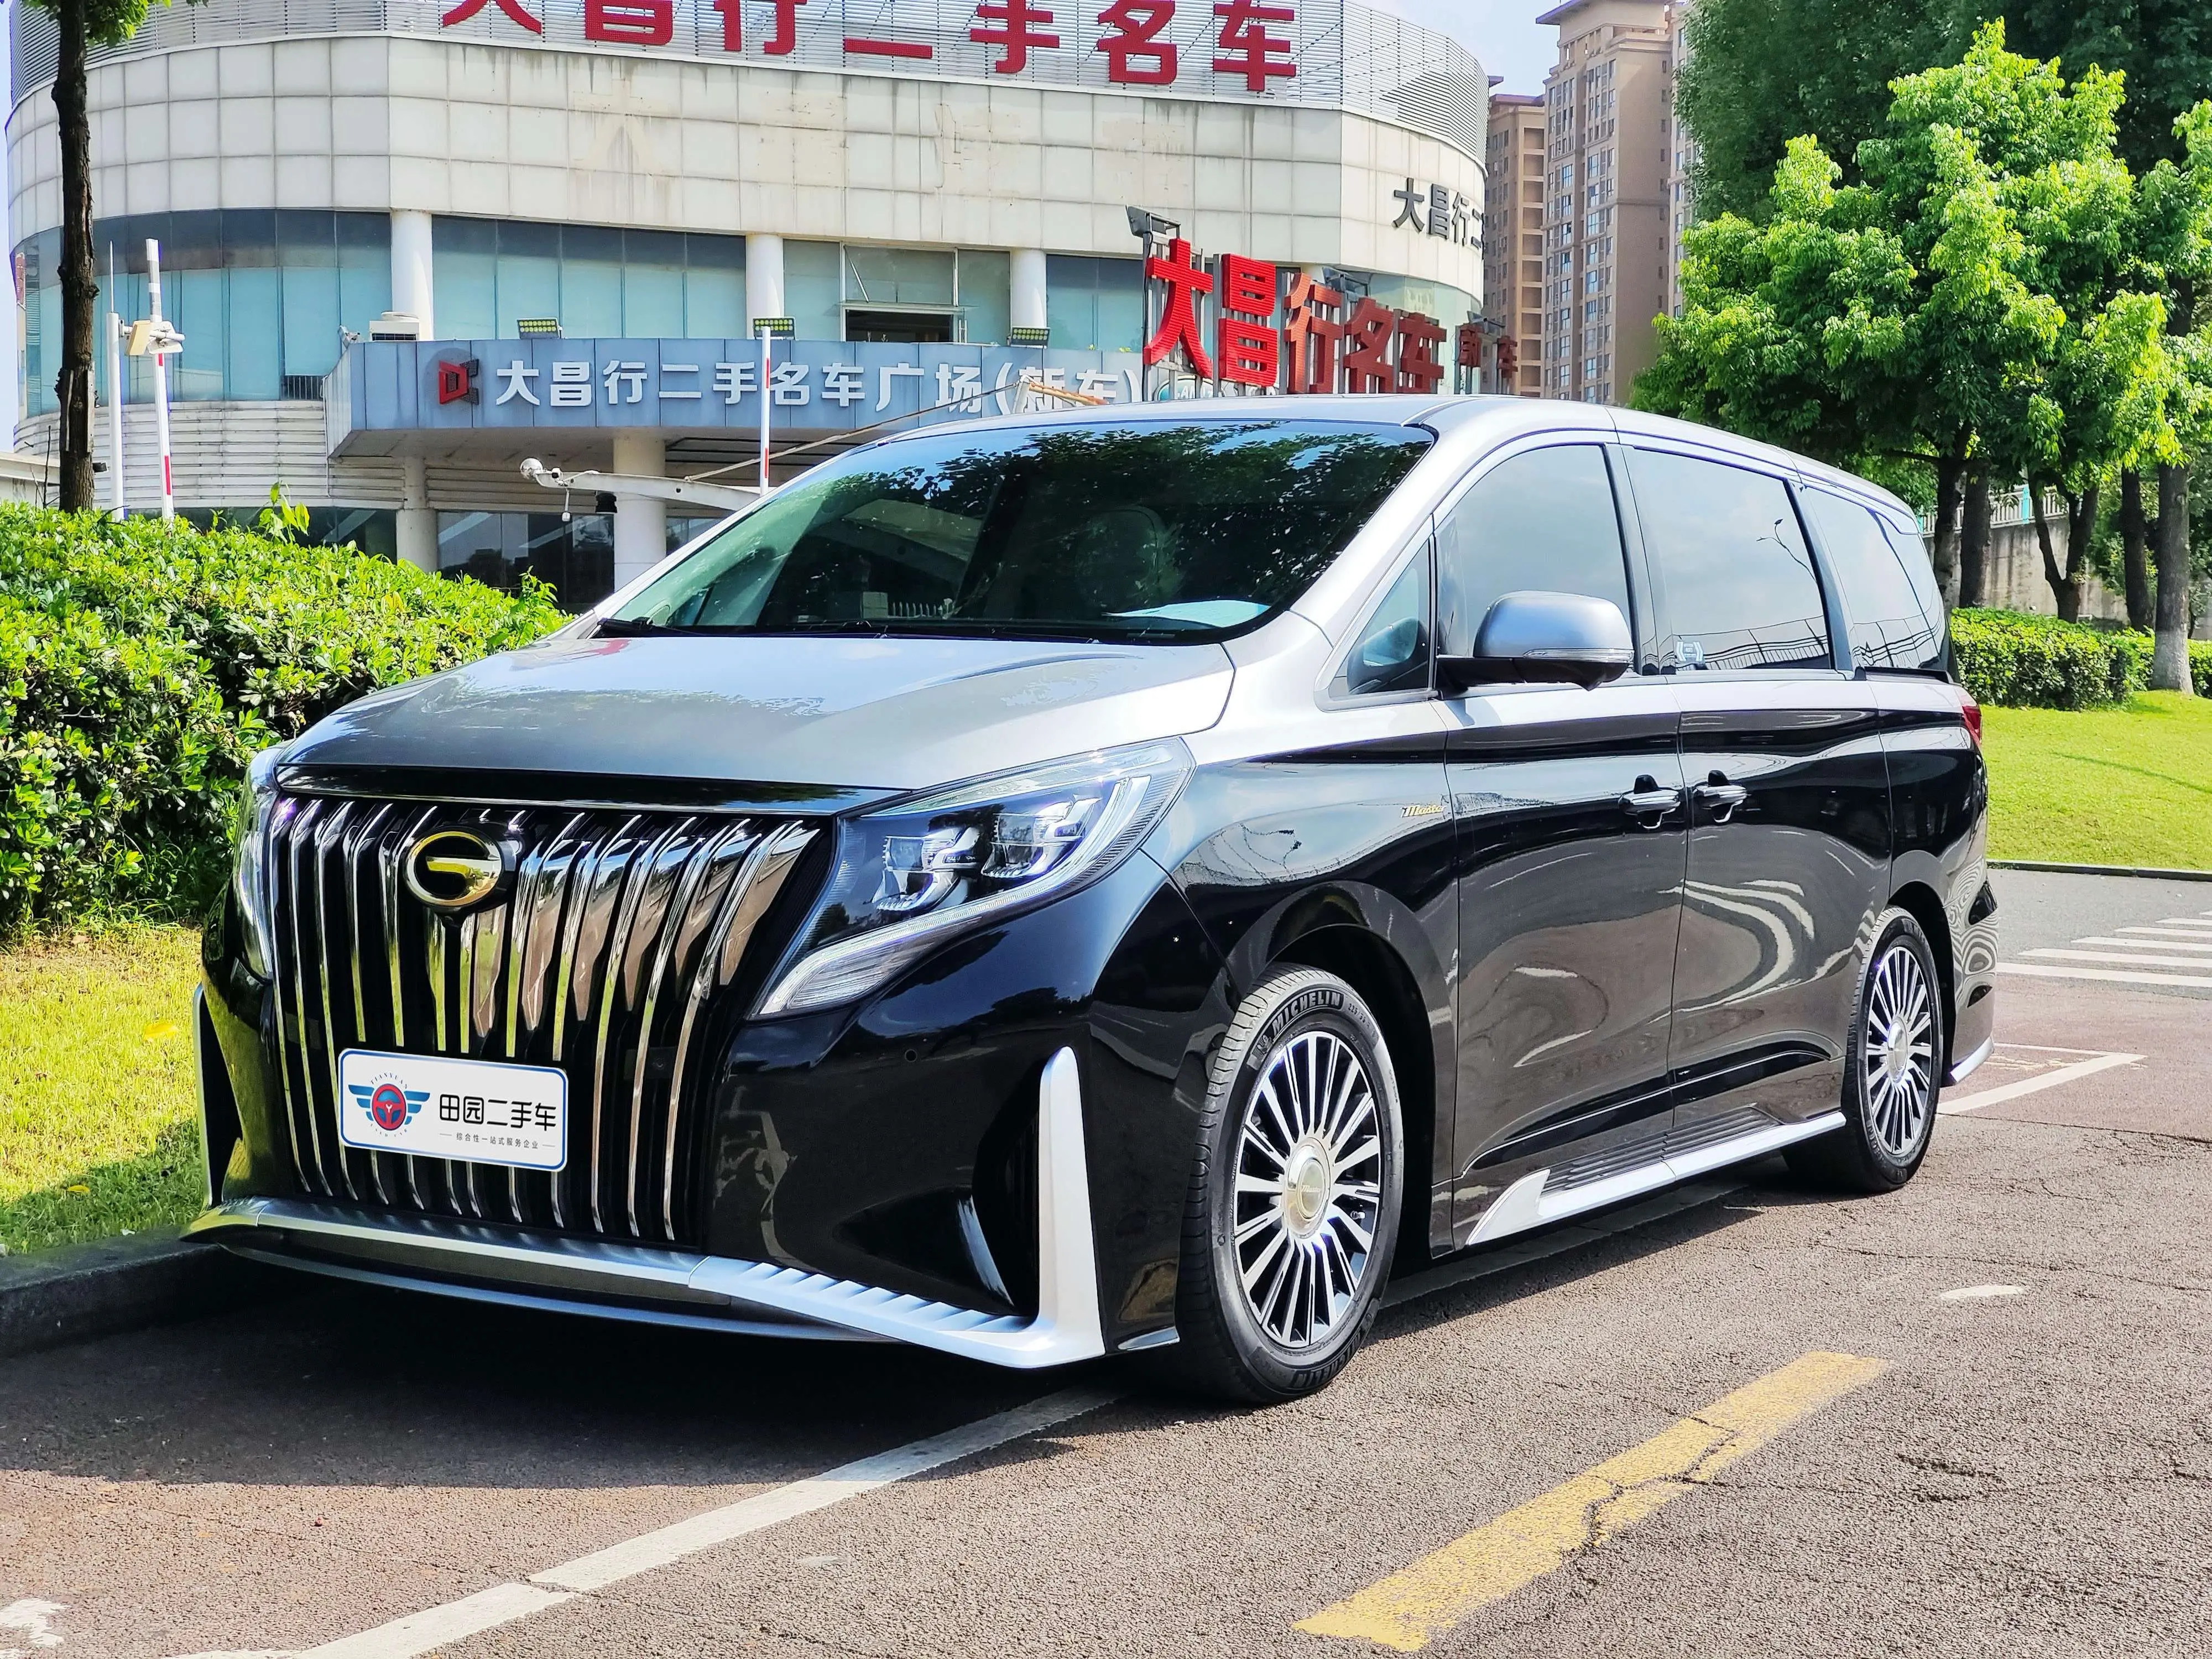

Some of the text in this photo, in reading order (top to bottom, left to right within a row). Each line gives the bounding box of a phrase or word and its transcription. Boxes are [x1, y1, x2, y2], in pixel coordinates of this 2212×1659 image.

[442, 0, 1297, 91] 昌行手名车
[1391, 178, 1485, 260] 大昌行二
[1143, 238, 1447, 394] 大昌行名车
[1272, 990, 1340, 1035] MICHELIN
[440, 1094, 556, 1131] 田园二手车
[456, 1133, 538, 1149] 综合性一站式服务企业
